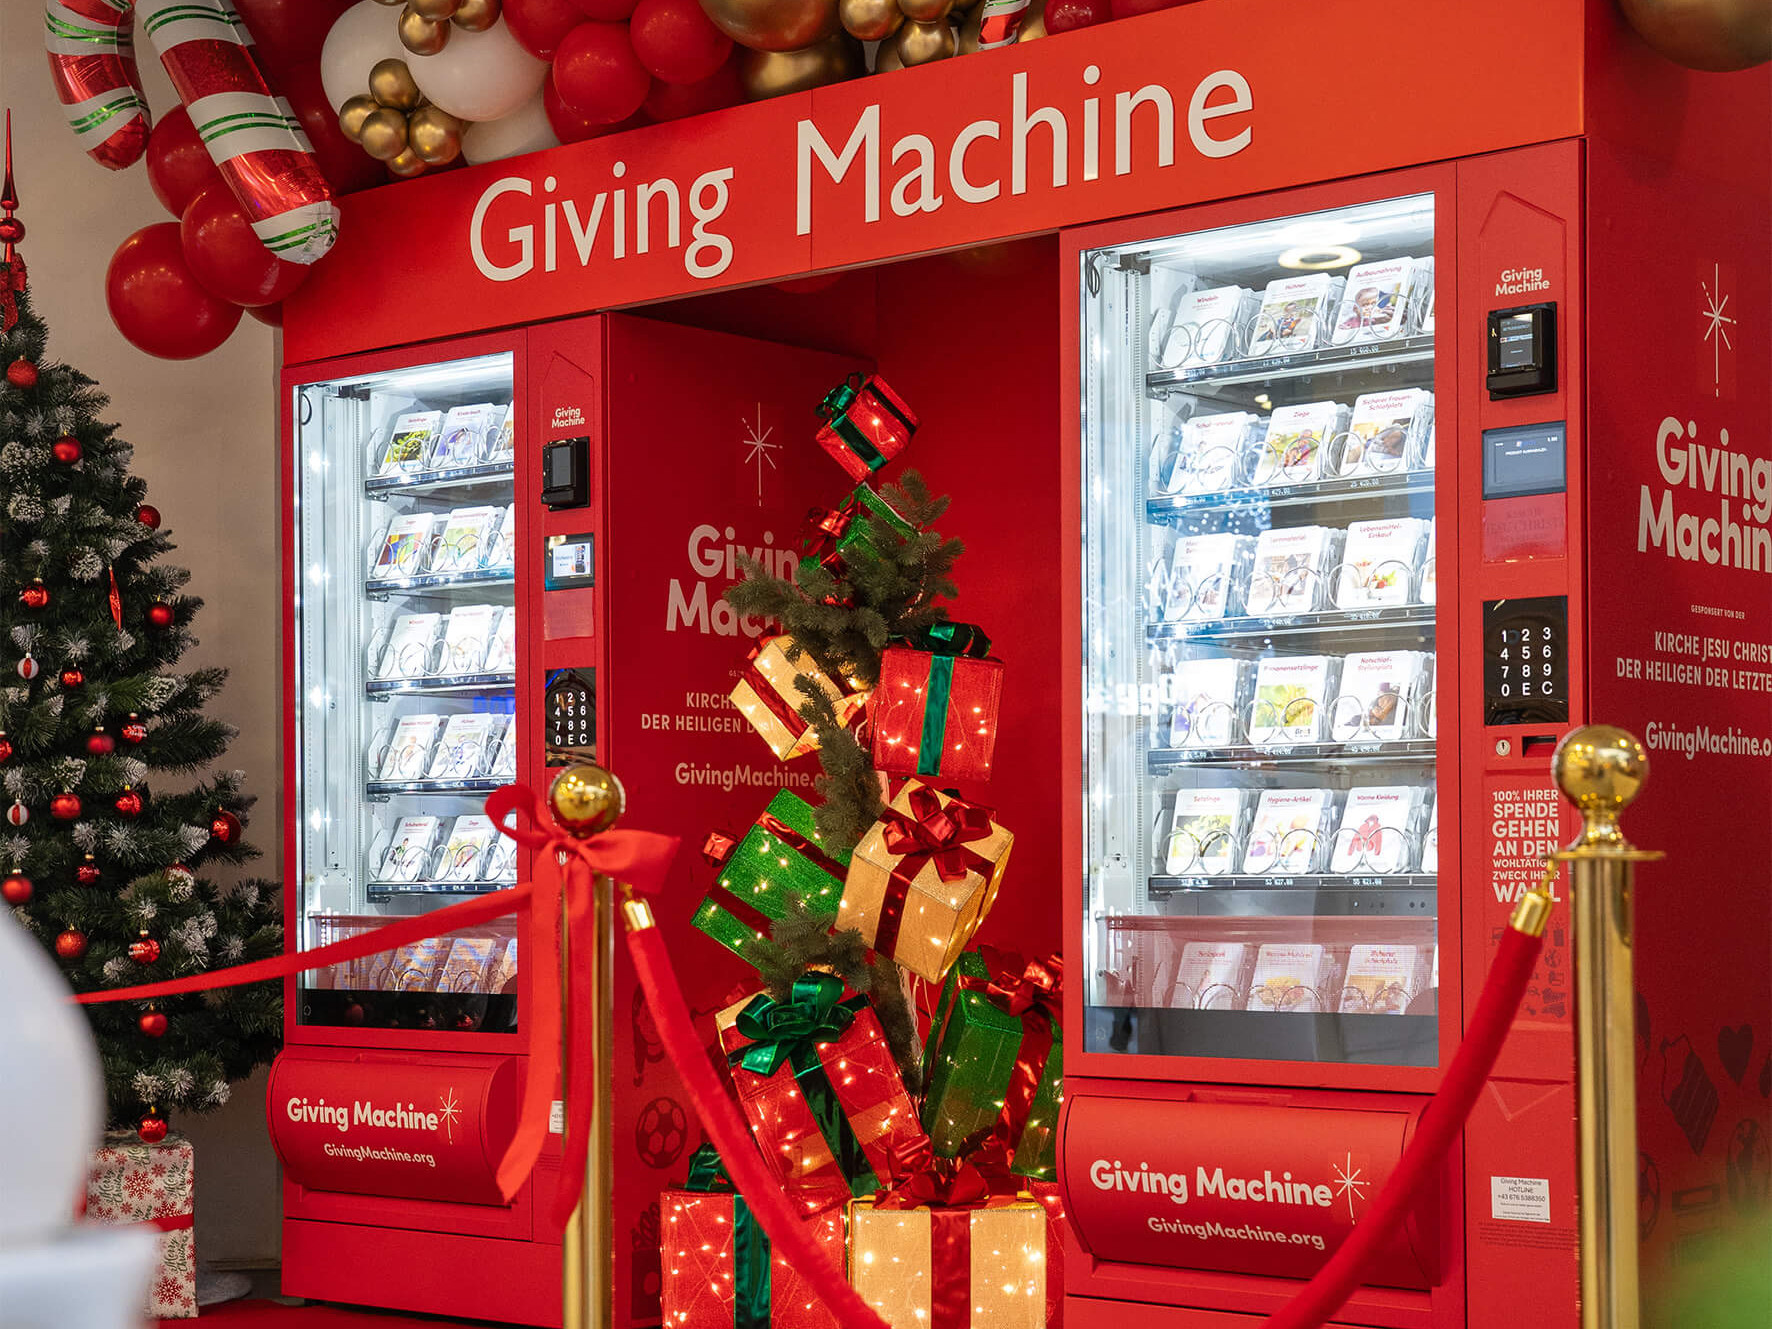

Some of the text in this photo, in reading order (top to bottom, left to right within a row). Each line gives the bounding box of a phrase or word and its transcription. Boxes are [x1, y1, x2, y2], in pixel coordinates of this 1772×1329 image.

[470, 65, 1254, 279] Giving Machine
[1501, 267, 1542, 282] Giving
[1495, 280, 1550, 297] Machine
[555, 407, 581, 418] Giving
[552, 417, 586, 428] Machine
[1656, 416, 1772, 524] Giving
[1637, 484, 1772, 574] Machin
[688, 524, 802, 587] Givin
[1691, 605, 1745, 620] GESPONSERT VON DER
[1502, 626, 1551, 642] 1 2 3
[1500, 645, 1552, 660] 4 5 6
[1655, 631, 1772, 664] KIRCHE JESU CHRIST
[1501, 664, 1552, 678] 7 8 9
[1616, 657, 1772, 693] DER HEILIGEN DER LETZTE
[1502, 681, 1552, 697] 0 E C
[555, 691, 586, 704] 1 2 3
[554, 705, 586, 717] 4 5 6
[555, 720, 586, 731] 7 8 9
[641, 713, 670, 731] DER
[675, 715, 741, 733] HEILIGEN
[555, 733, 587, 746] 0 E C
[1646, 721, 1772, 760] GivingMachine.o
[675, 762, 834, 792] GivingMachine.
[1492, 789, 1559, 801] 100% IHRER
[1493, 802, 1559, 818] SPENDE
[1492, 820, 1559, 838] GEHEN
[1492, 840, 1559, 857] AN DEN
[1492, 856, 1549, 868] WOHLTÄTIG
[1492, 870, 1560, 880] ZWECK IHRR
[1492, 881, 1561, 902] WAL
[287, 1097, 439, 1132] Giving Machine
[323, 1142, 436, 1168] GivingMachine.org
[1090, 1160, 1333, 1207] Giving Machine
[1509, 1186, 1533, 1194] HOTLINE
[1147, 1217, 1325, 1250] GivingMachine.org
